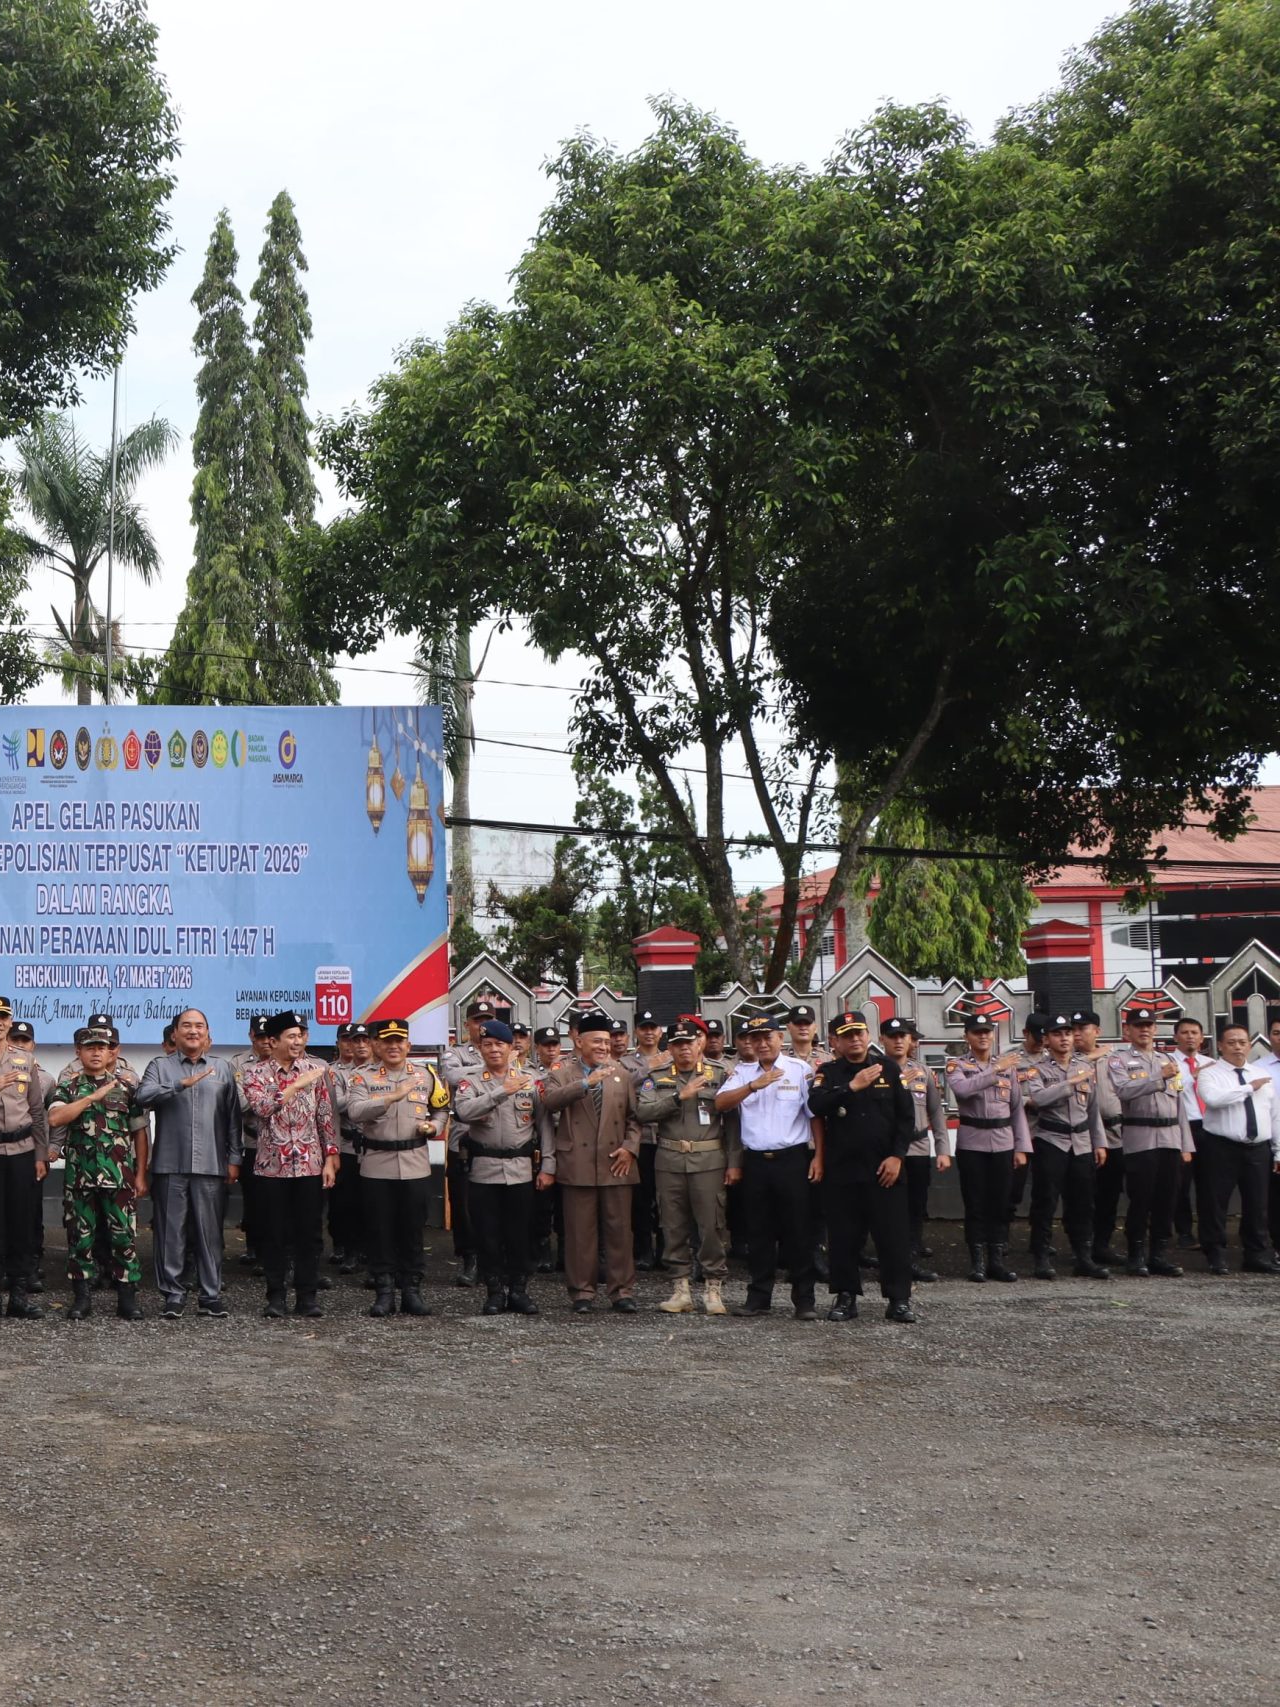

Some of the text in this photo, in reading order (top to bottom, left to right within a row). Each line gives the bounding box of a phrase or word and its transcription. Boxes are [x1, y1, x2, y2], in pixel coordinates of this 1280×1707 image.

[248, 755, 271, 763] NASIONAL
[11, 801, 200, 832] APEL GELAR PASUKAN
[84, 843, 172, 873] TERPUSAT
[36, 884, 173, 915] DALAM RANGKA
[39, 925, 128, 956] PERAYAAN
[133, 926, 172, 956] IDUL
[176, 926, 217, 956] FITRI
[222, 926, 258, 956] 1447
[263, 926, 275, 956] H
[15, 965, 192, 993] BENGKULU UTARA, 12 MARET 2026
[236, 990, 311, 1002] LAYANAN KEPOLISIAN
[319, 995, 349, 1016] 110
[12, 996, 49, 1024] Mudik
[49, 998, 86, 1024] Aman,
[90, 996, 140, 1027] Keluarga
[236, 1008, 260, 1020] BEBAS
